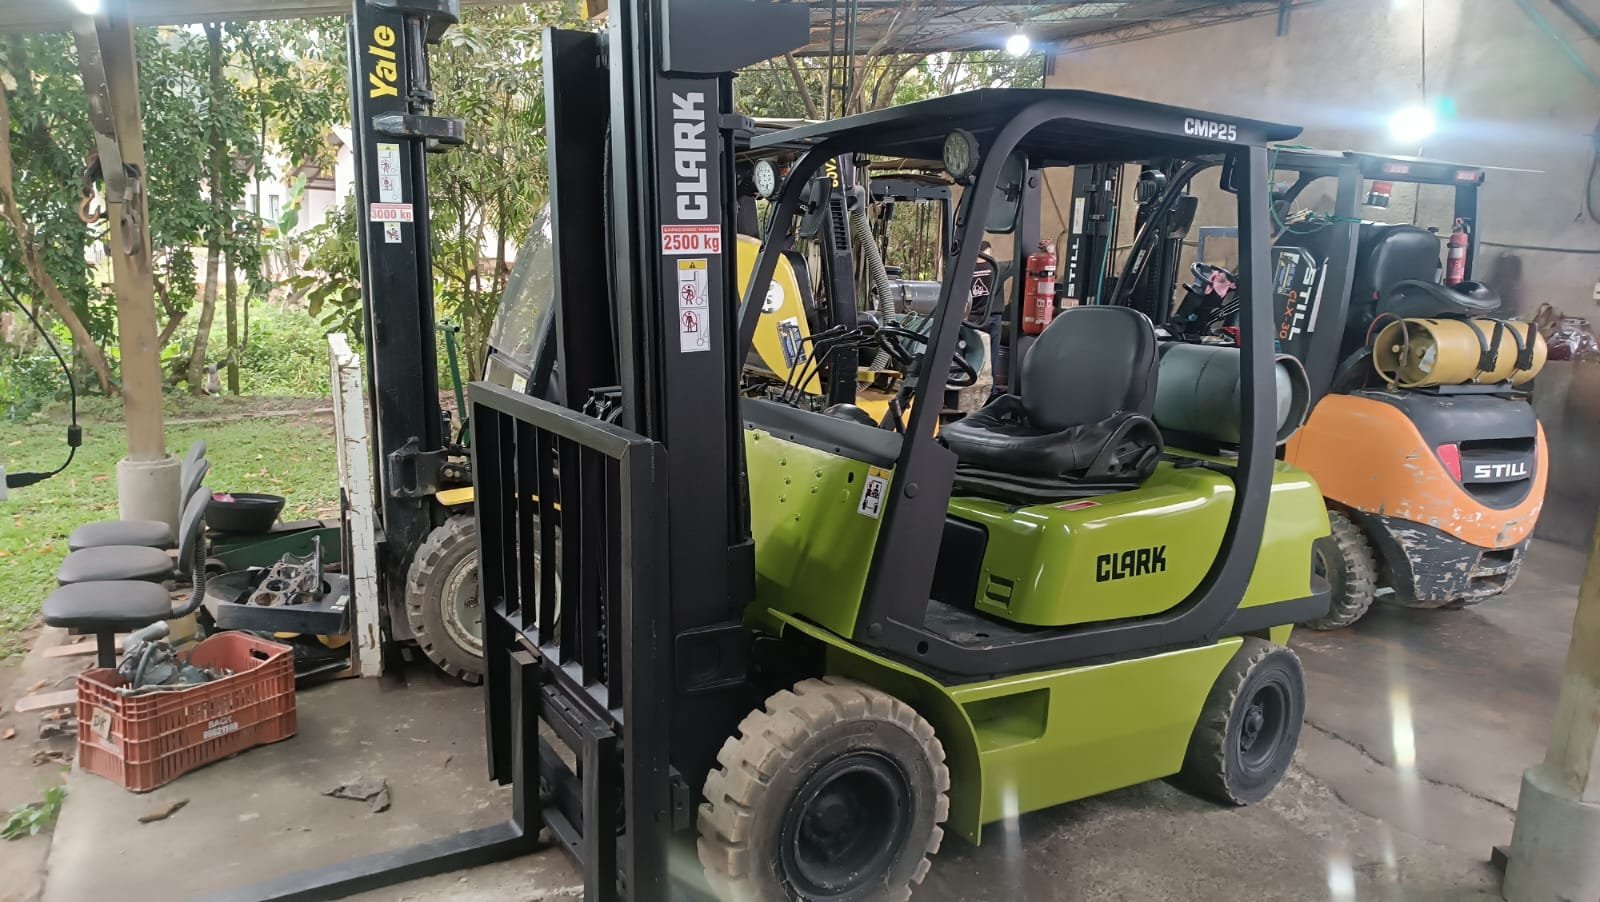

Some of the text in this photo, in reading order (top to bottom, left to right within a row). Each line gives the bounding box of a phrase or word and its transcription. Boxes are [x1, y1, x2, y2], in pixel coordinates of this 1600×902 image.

[368, 25, 398, 98] Yale
[1184, 117, 1237, 141] CMP25
[672, 92, 708, 220] CLARK
[370, 209, 412, 220] 3000 kg
[663, 234, 720, 252] 2500 kg
[1067, 237, 1080, 297] STILL
[1288, 267, 1317, 341] STILL
[1473, 462, 1528, 479] STILL
[1096, 545, 1167, 583] CLARK
